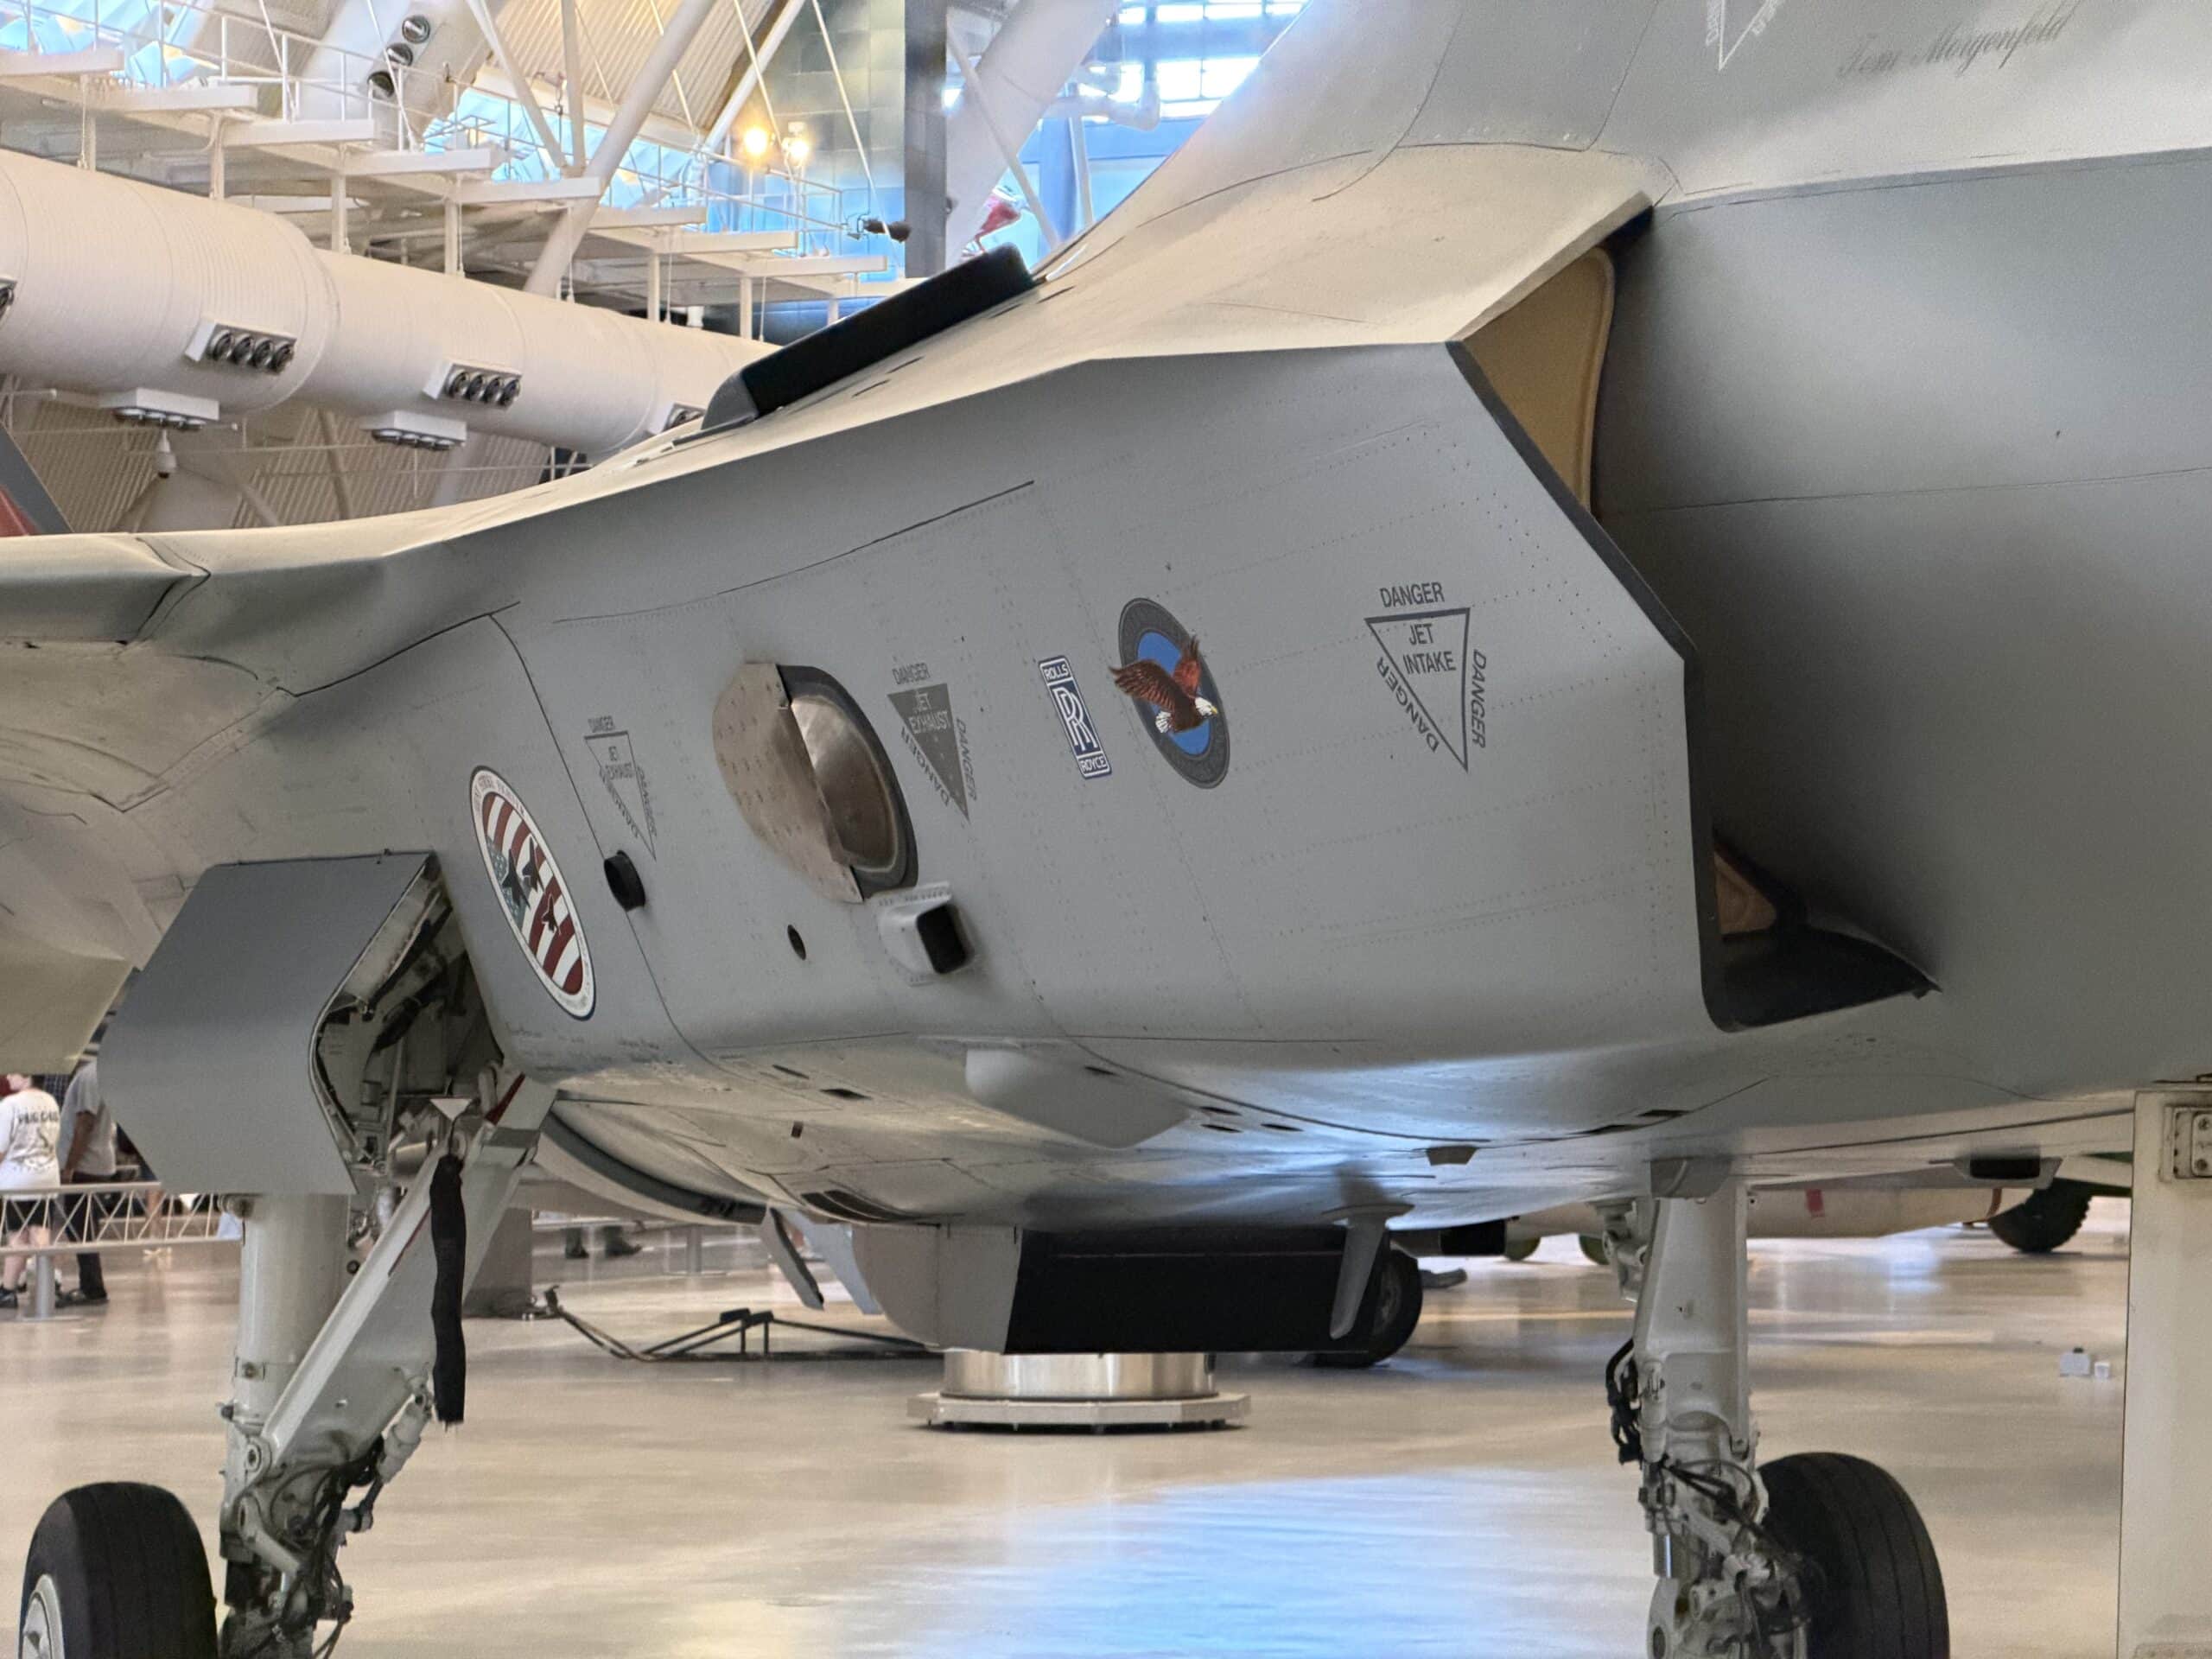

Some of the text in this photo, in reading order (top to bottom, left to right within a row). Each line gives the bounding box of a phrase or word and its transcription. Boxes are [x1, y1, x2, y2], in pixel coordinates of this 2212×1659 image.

[1380, 582, 1445, 607] DANGER
[1408, 623, 1434, 645] JET
[893, 663, 930, 685] DANGER
[1044, 662, 1070, 681] ROLLS
[1403, 651, 1456, 675] INTAKE
[913, 692, 931, 712] JET
[1376, 657, 1440, 753] DANGER
[1471, 649, 1486, 748] DANGER
[908, 711, 949, 734] EXHAUST
[901, 726, 950, 807] DANGER
[957, 718, 977, 803] DANGER
[1080, 755, 1107, 773] ROYCE
